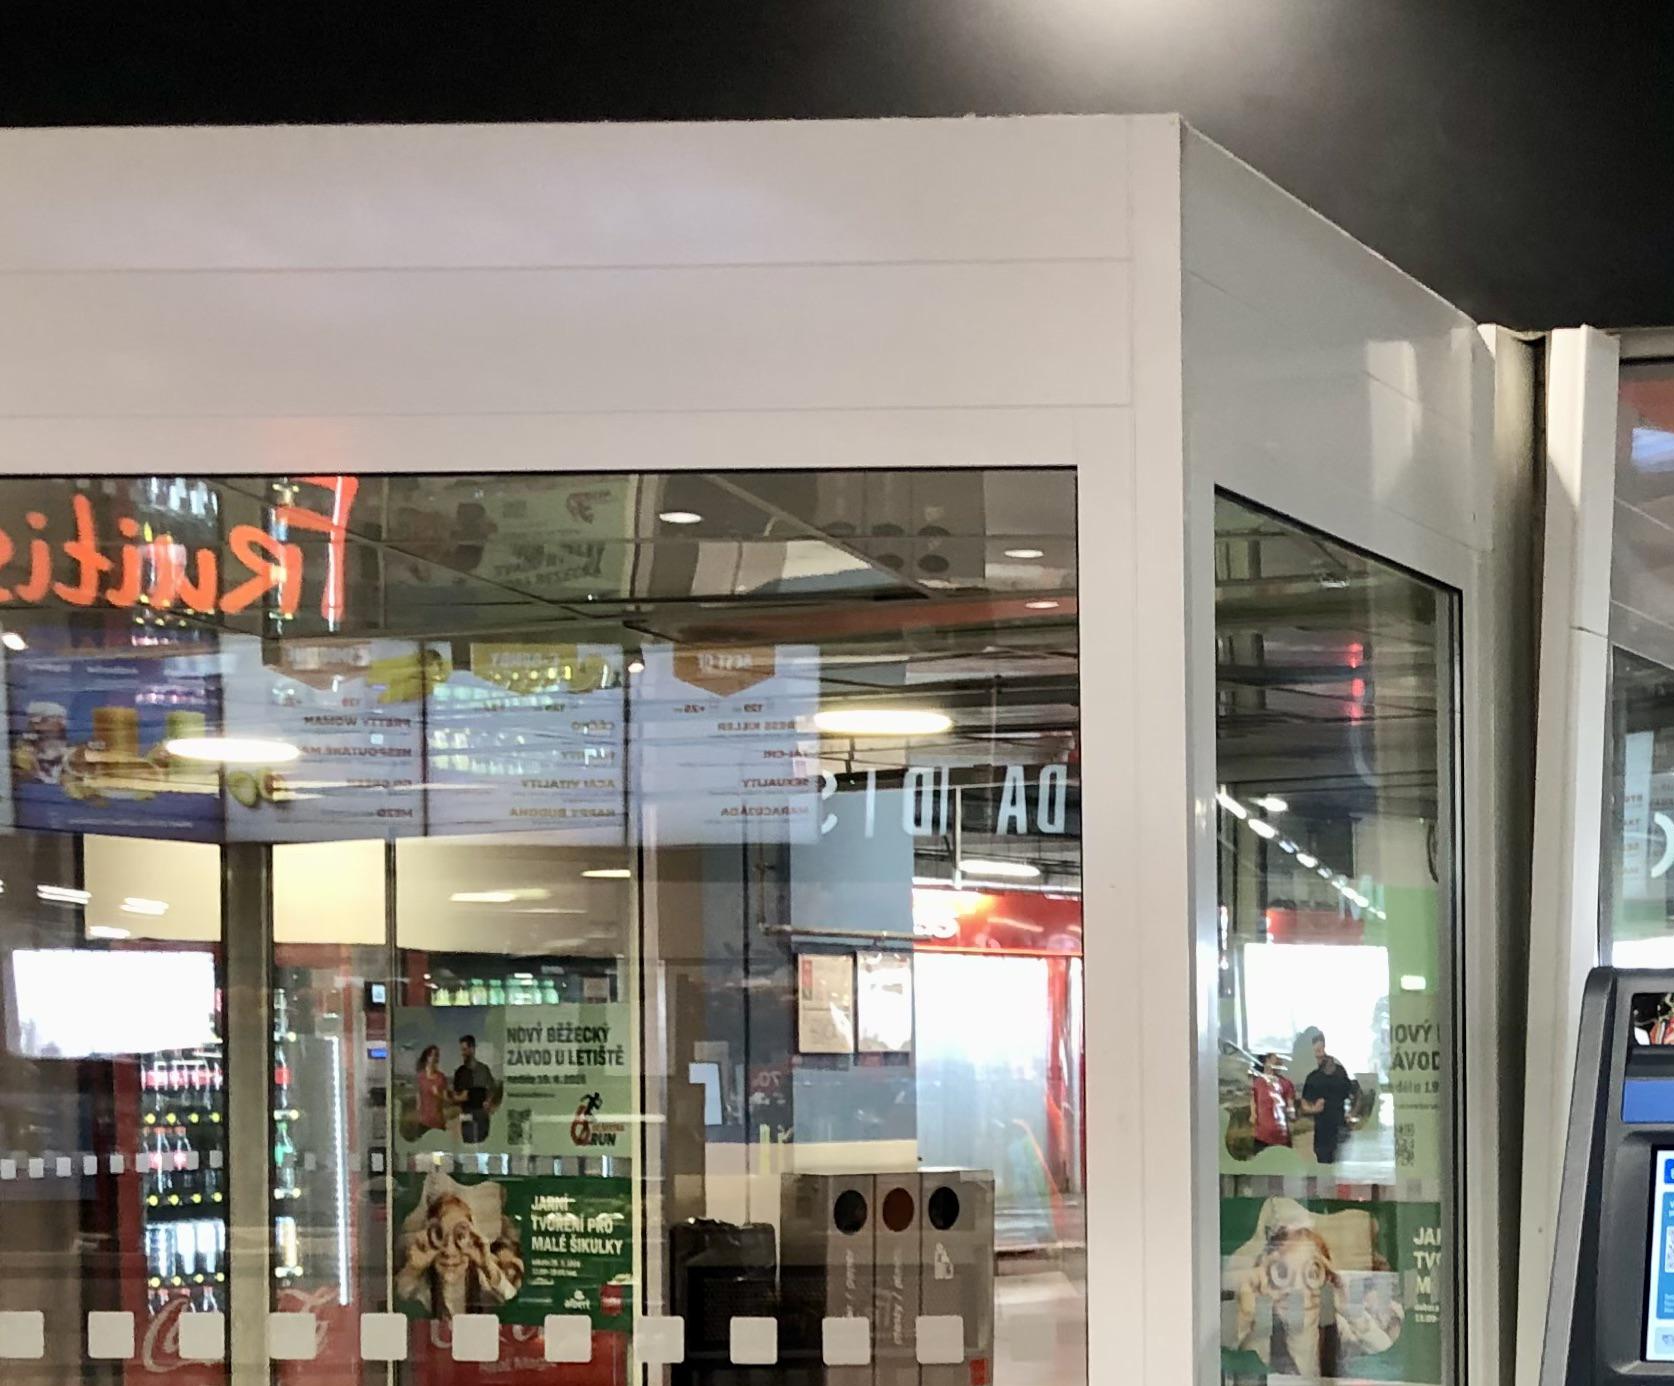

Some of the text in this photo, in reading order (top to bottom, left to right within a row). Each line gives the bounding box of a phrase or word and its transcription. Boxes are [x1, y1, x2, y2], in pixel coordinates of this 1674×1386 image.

[507, 1021, 609, 1044] NOVÝ BĚŽECKÝ
[1390, 1019, 1432, 1043] OVÝ
[555, 1050, 565, 1066] U
[568, 1045, 624, 1066] LETIŠTĚ
[531, 1193, 569, 1212] JARNÍ
[588, 1217, 613, 1234] PRO
[532, 1234, 624, 1255] MALÉ ŠIKULKY
[564, 1297, 591, 1311] albert
